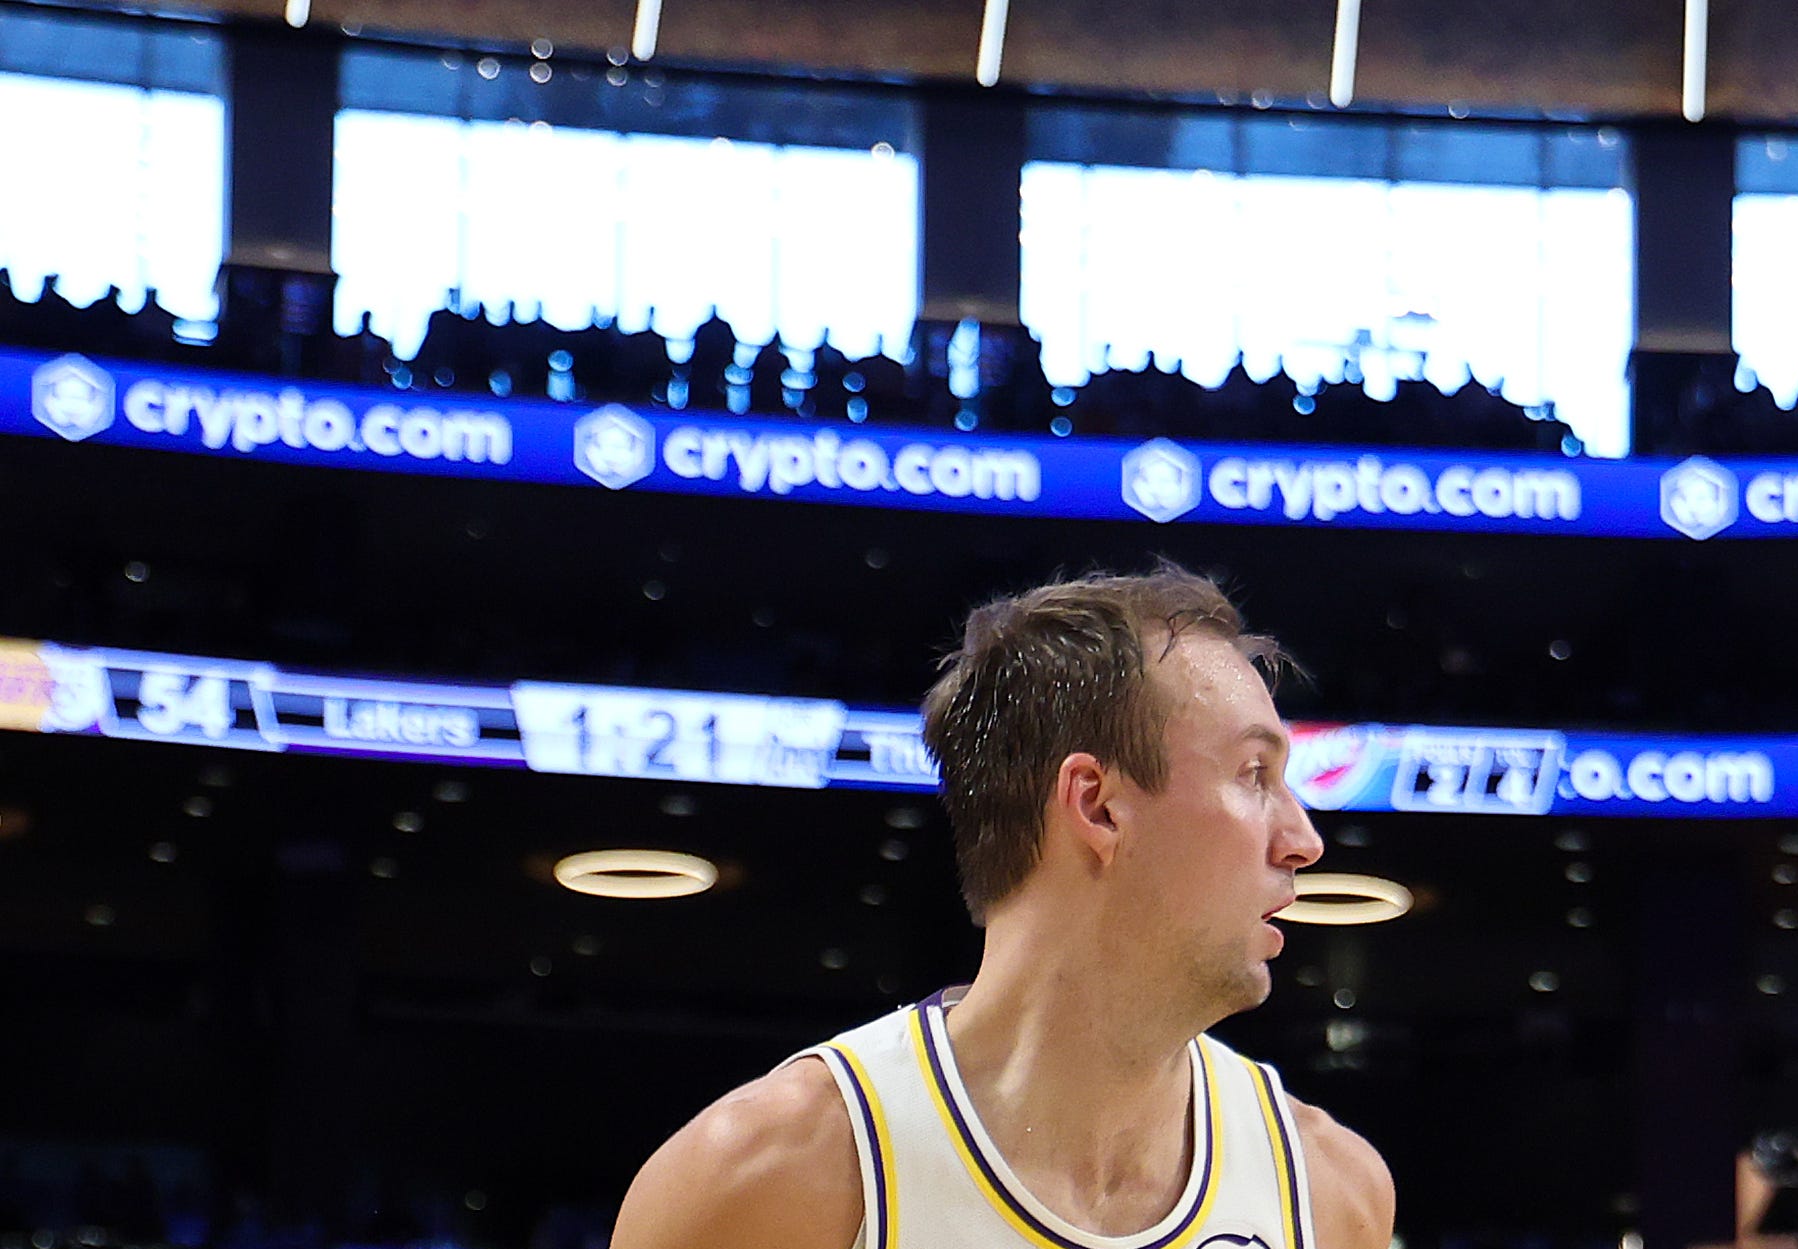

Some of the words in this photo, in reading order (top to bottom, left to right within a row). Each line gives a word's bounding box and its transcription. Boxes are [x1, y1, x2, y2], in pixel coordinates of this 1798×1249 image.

[123, 377, 513, 465] crypto.com
[662, 428, 1041, 496] crypto.com
[1208, 454, 1583, 522] crypto.com
[137, 668, 233, 739] 54
[322, 697, 482, 749] Lakers
